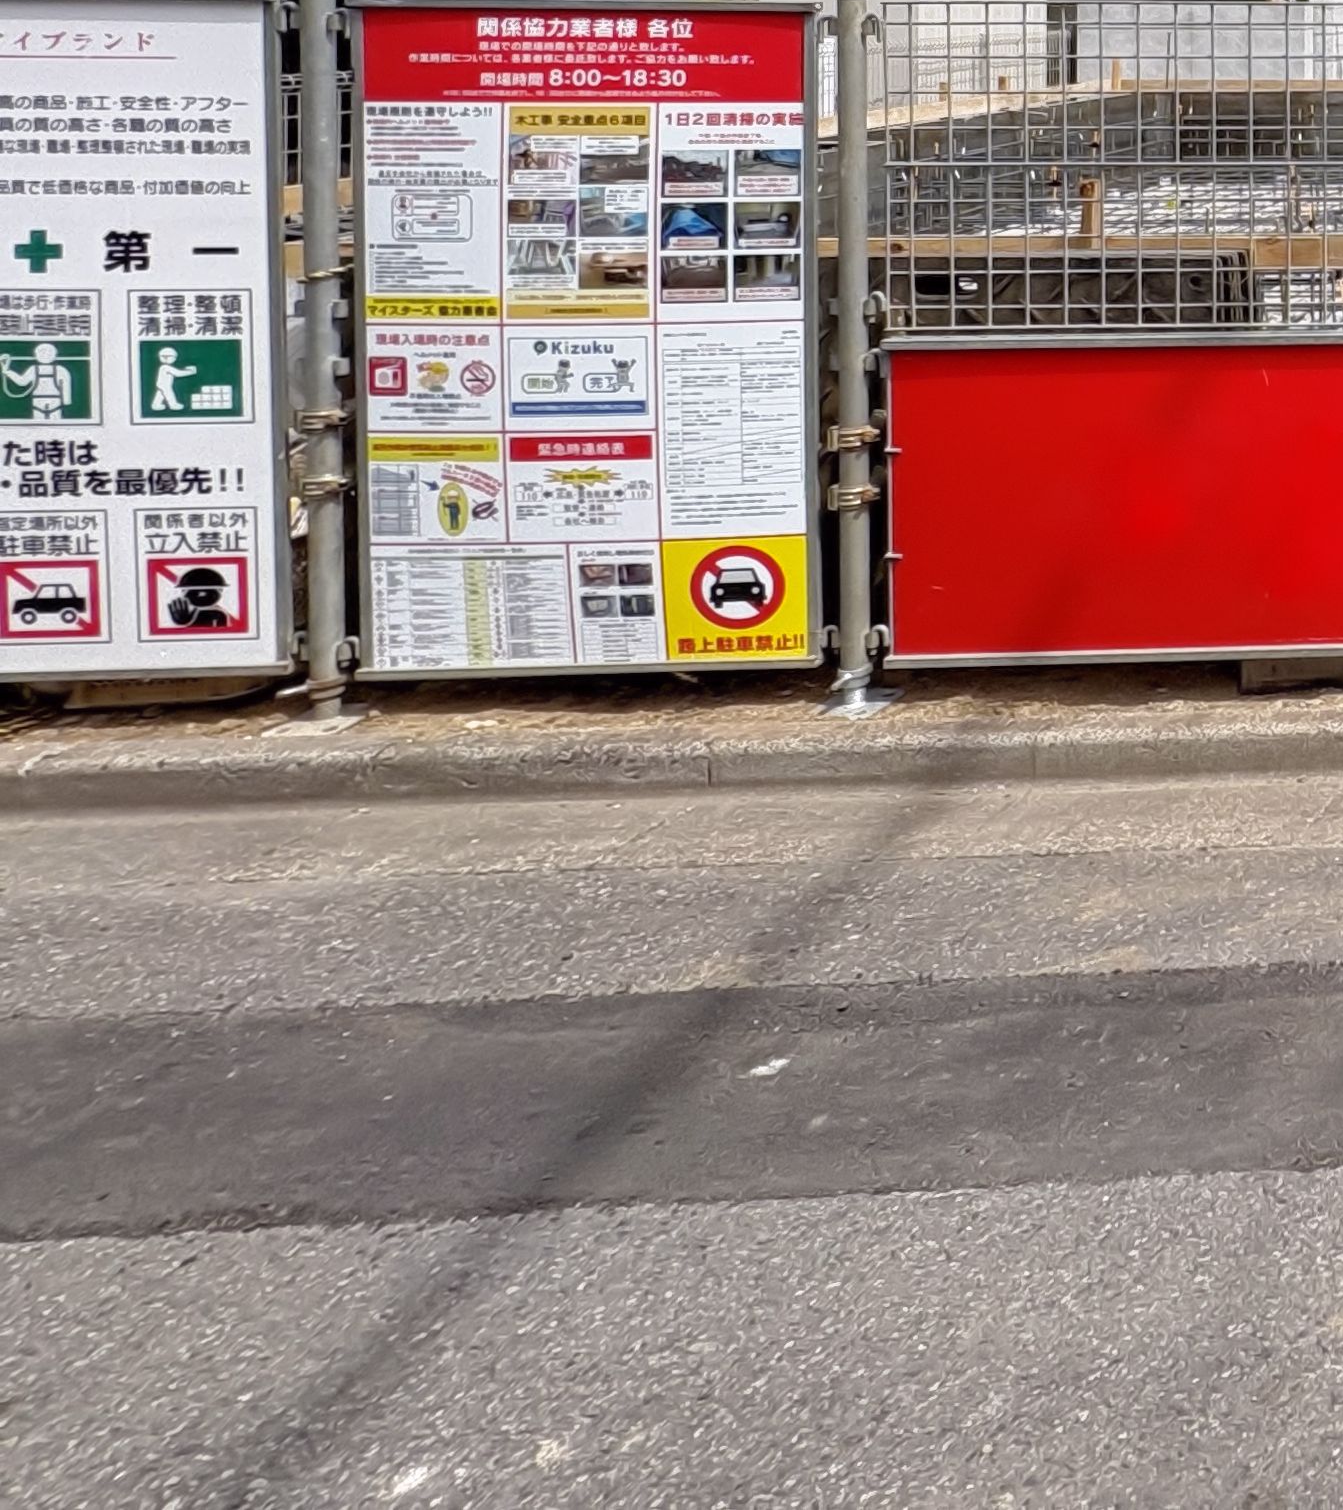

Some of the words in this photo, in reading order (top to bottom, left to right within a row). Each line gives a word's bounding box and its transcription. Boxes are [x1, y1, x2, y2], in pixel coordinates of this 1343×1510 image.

[477, 17, 639, 38] 関係協力業者様
[647, 18, 695, 39] 各位
[137, 295, 242, 315] 整理・整頓
[137, 316, 243, 336] 清掃・清潔
[552, 340, 614, 355] Kizuku
[143, 512, 249, 530] 関係者以外
[0, 533, 100, 557] 駐車禁止
[144, 532, 248, 555] 立入禁止
